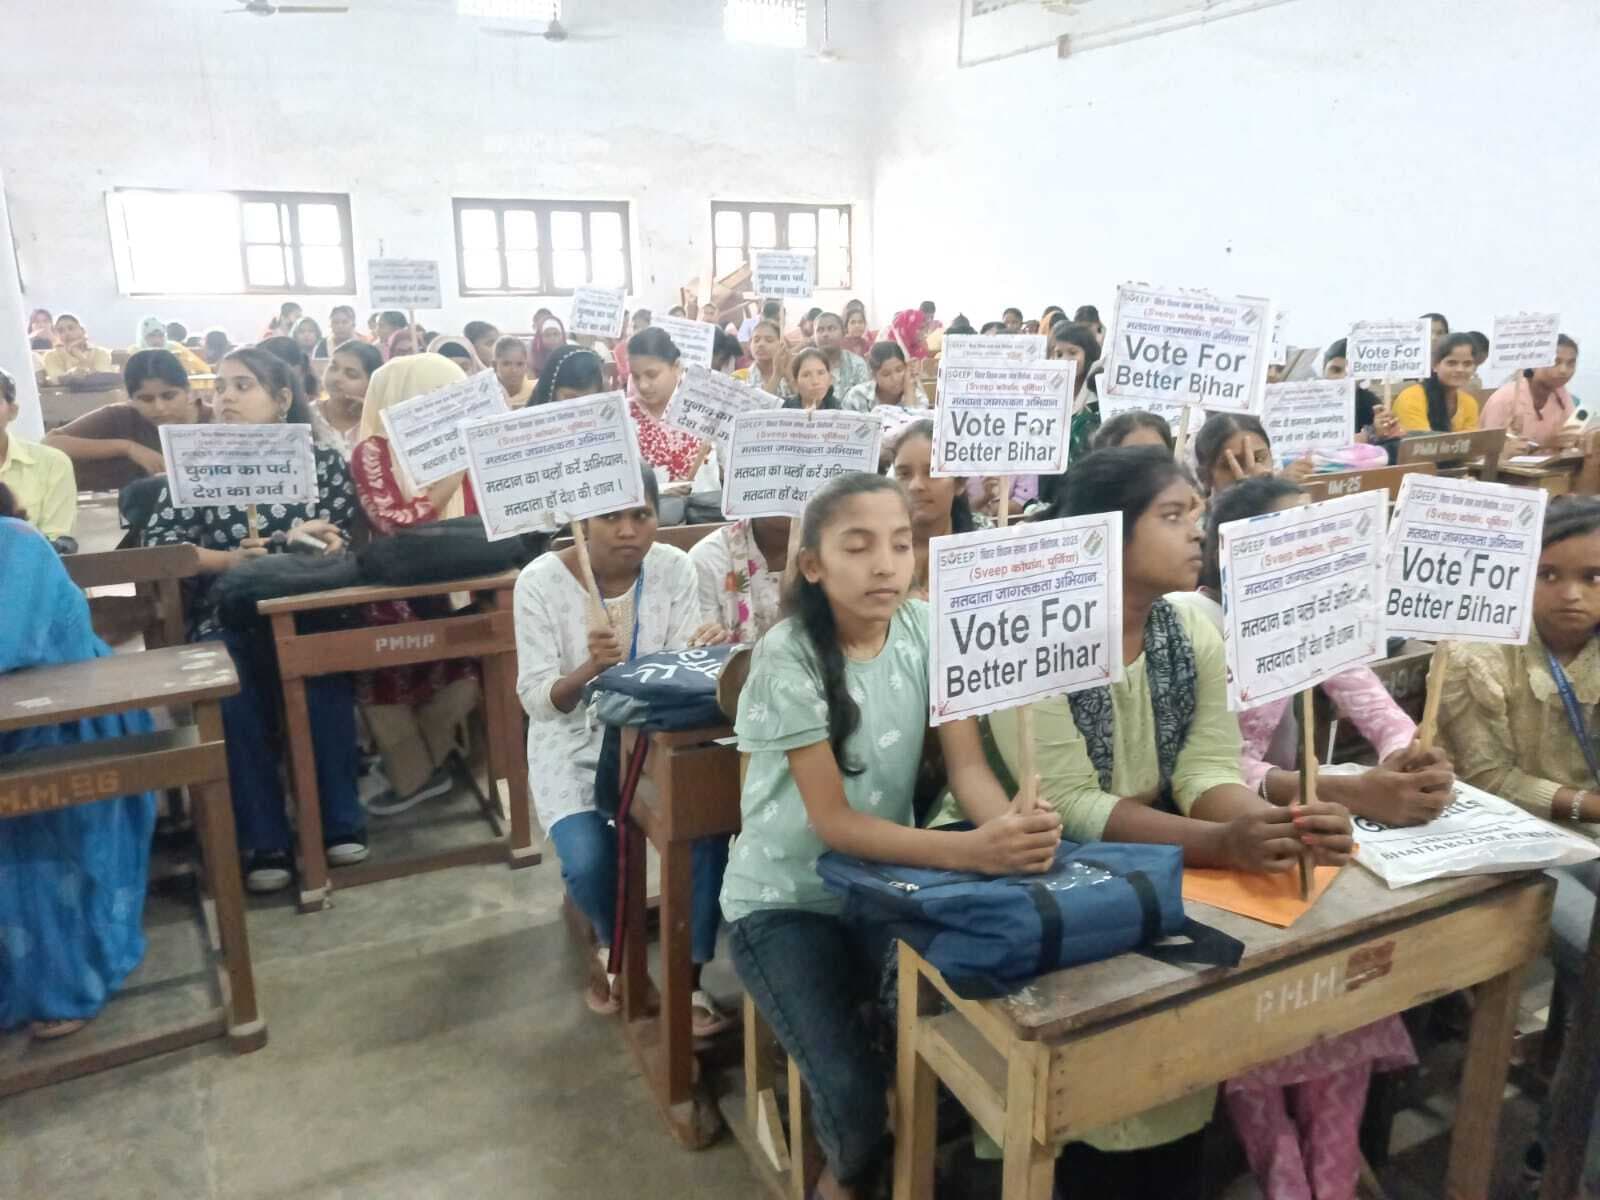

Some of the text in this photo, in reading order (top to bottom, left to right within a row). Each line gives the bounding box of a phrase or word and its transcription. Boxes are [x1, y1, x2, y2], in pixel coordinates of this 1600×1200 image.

[1126, 335, 1246, 373] Vote For
[1356, 345, 1420, 359] Vote For
[1353, 361, 1388, 372] Better
[1115, 365, 1245, 399] Better Bihar
[951, 411, 1056, 436] Vote For
[944, 441, 1056, 462] Better Bihar
[184, 464, 232, 482] चुनाव
[238, 464, 261, 475] का
[485, 475, 523, 493] मतदान
[525, 471, 540, 484] का
[768, 465, 781, 477] का
[192, 484, 221, 498] देश
[226, 485, 250, 497] का
[255, 480, 284, 495] गर्व
[503, 497, 544, 517] मतदाता
[560, 488, 576, 504] देश
[578, 482, 592, 499] की
[742, 488, 775, 502] मतदाता
[969, 564, 1008, 582] (Sveep
[1402, 546, 1520, 591] Vote For
[950, 590, 992, 609] मतदाता
[1054, 570, 1097, 590] अभियान
[1386, 588, 1517, 625] Better Bihar
[950, 597, 1098, 656] Vote For
[1241, 612, 1280, 638] मतदान
[1282, 607, 1295, 626] का
[946, 641, 1101, 698] Better Bihar
[1256, 647, 1295, 675] मतदाता
